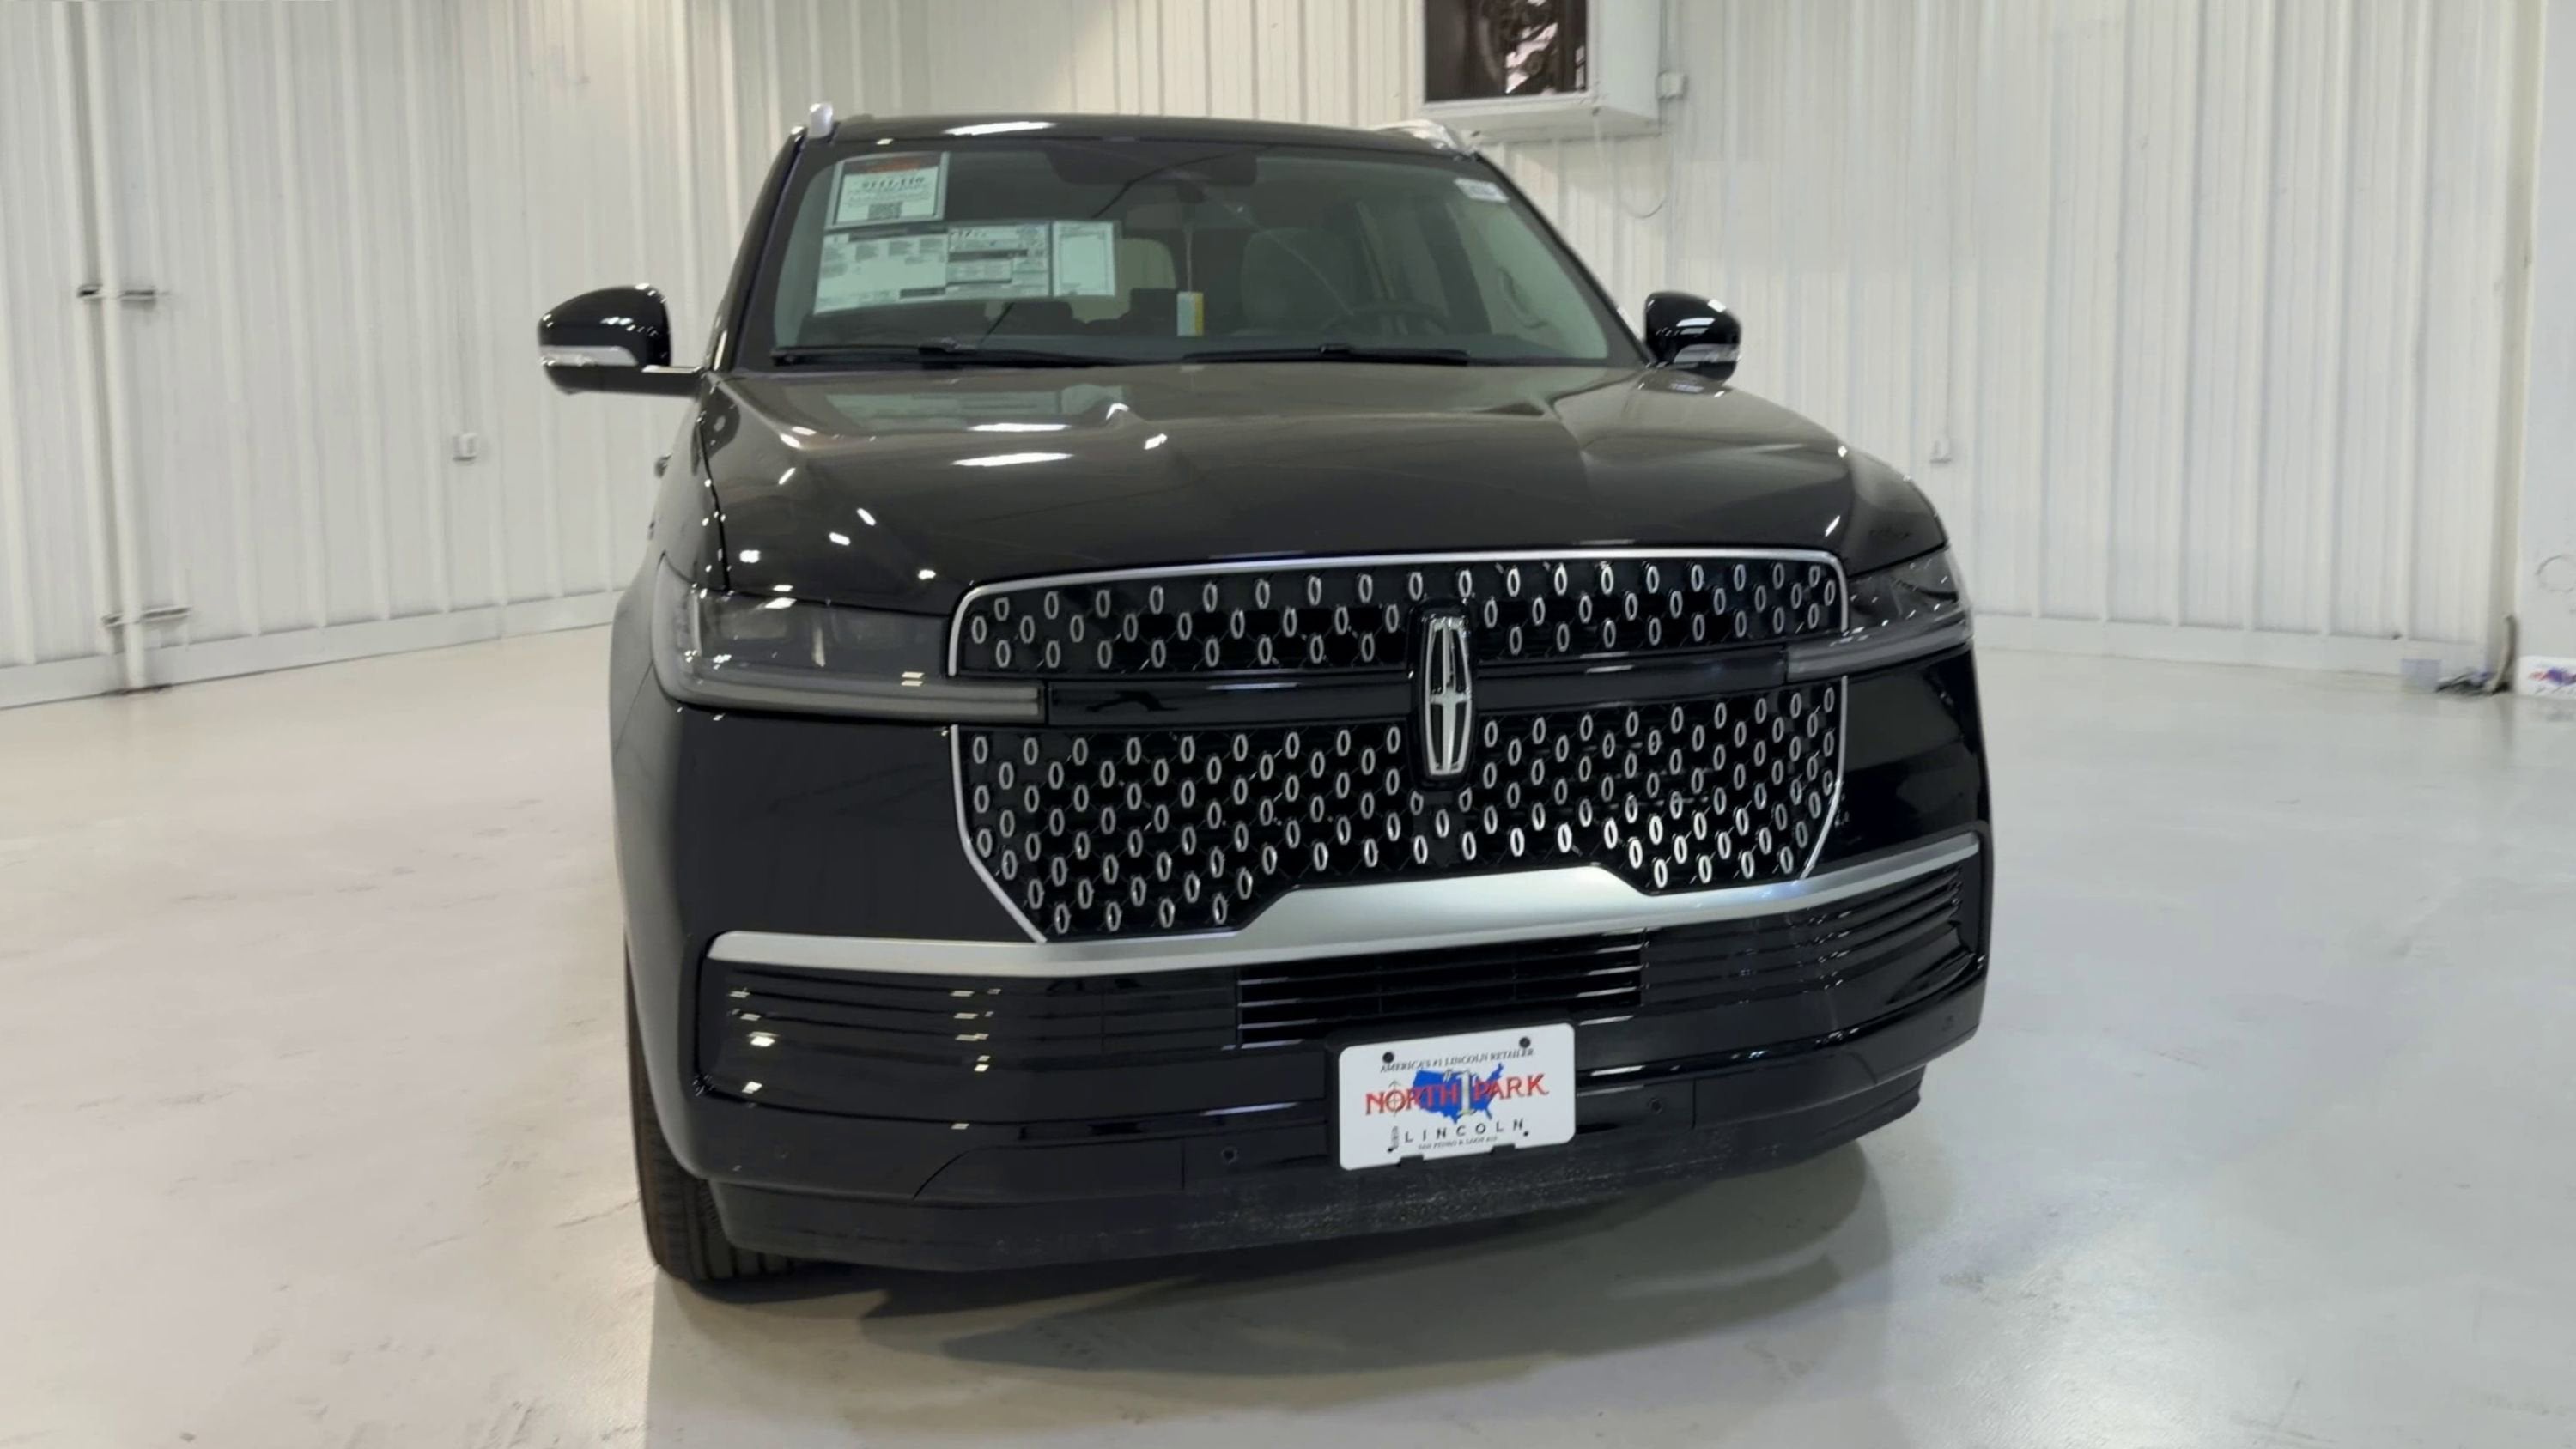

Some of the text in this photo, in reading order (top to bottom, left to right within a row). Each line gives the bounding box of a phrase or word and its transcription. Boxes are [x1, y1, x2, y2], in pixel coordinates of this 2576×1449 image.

[1381, 1060, 1431, 1073] AMERICA'S
[1445, 1053, 1488, 1066] LINCOLN
[1490, 1048, 1534, 1061] RETAILER
[1365, 1073, 1550, 1116] NORTH PARK
[1405, 1118, 1524, 1143] LINCOLN
